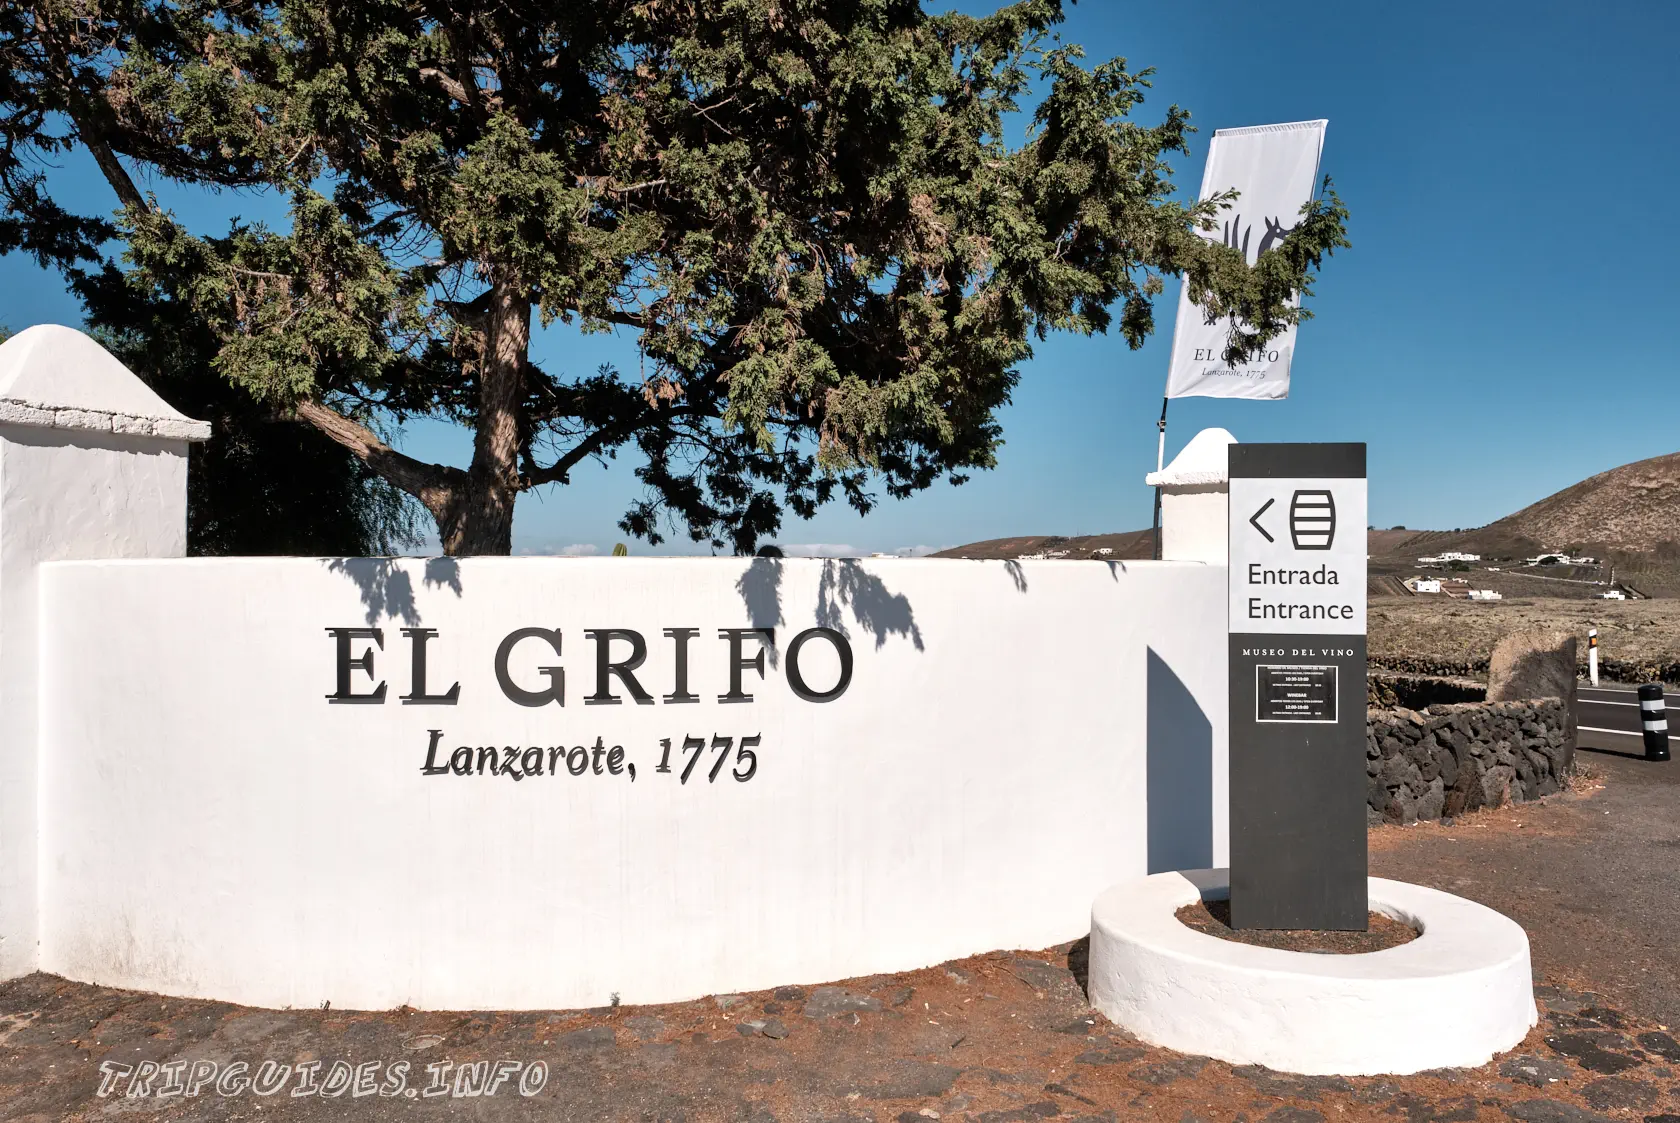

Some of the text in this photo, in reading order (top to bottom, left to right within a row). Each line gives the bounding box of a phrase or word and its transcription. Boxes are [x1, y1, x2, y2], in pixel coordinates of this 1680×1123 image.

[1193, 348, 1216, 361] EL
[1201, 367, 1267, 380] Lanzarote, 1775
[1248, 563, 1340, 585] Entrada
[1248, 597, 1354, 619] Entrance
[324, 625, 854, 708] EL GRIFO
[419, 728, 762, 785] Lanzarote, 1775
